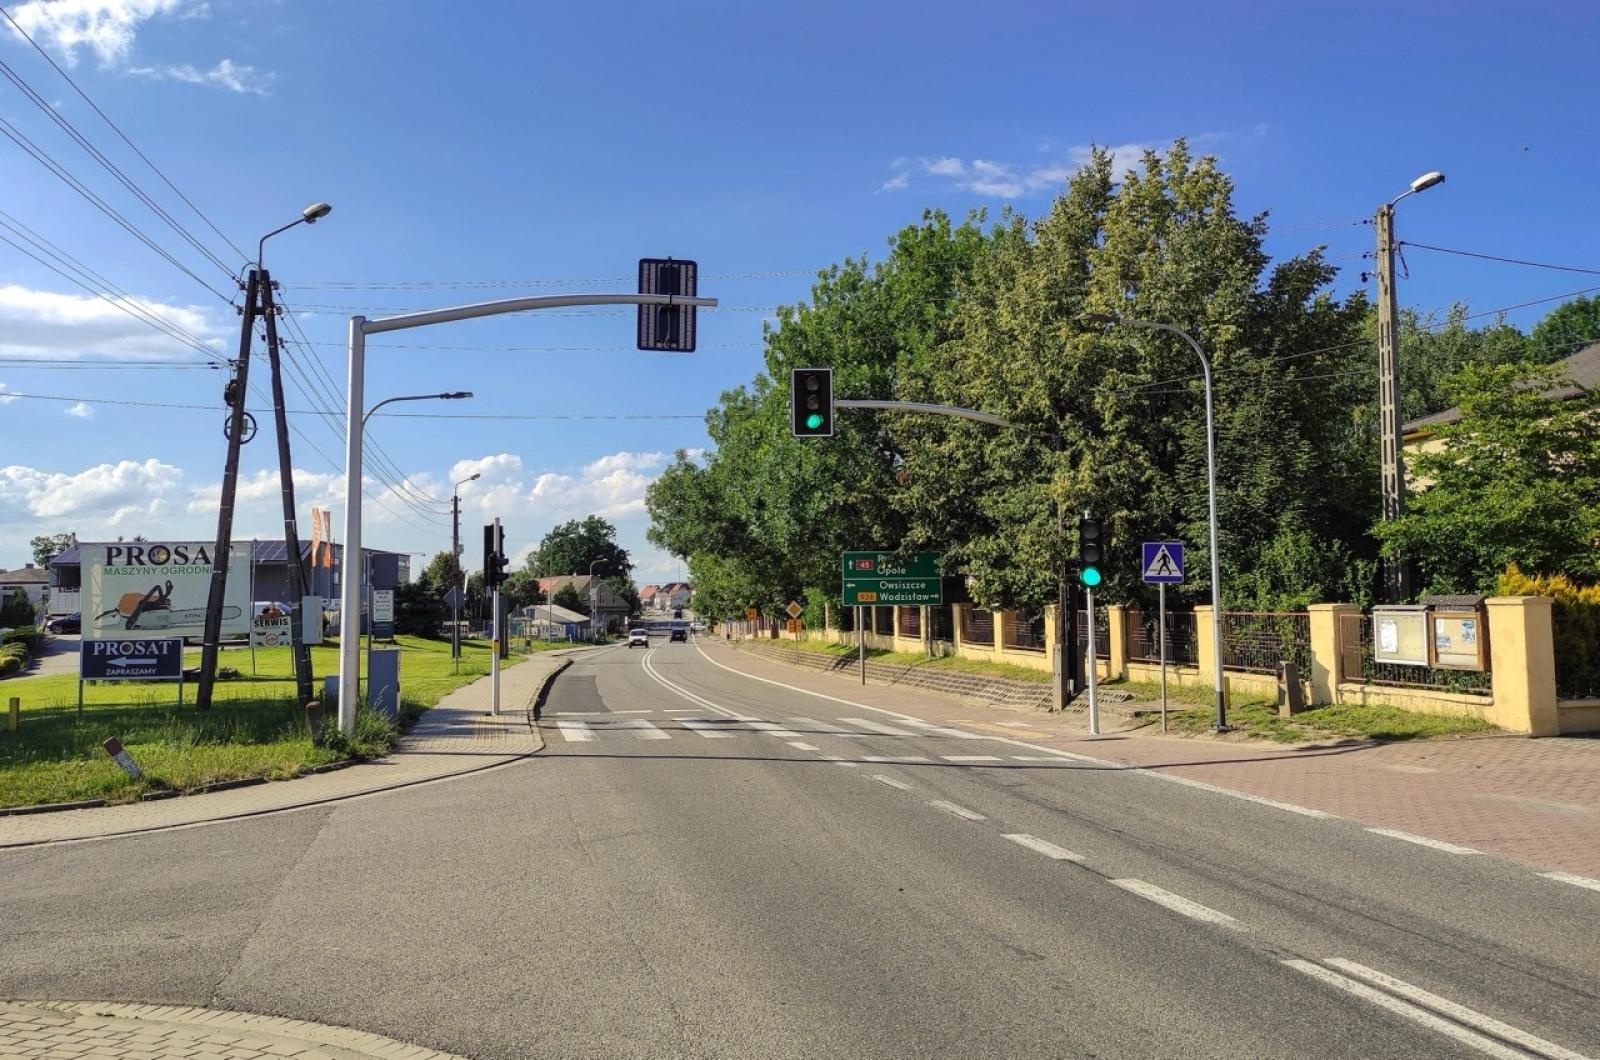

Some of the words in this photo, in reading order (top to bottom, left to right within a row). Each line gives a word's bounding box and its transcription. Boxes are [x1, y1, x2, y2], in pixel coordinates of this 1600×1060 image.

[104, 545, 233, 566] PROSA
[104, 566, 157, 576] MASZYNY
[160, 565, 233, 575] OGRODNIE
[877, 565, 906, 576] Opole
[880, 581, 926, 590] Owsiszcze
[880, 592, 930, 601] Wodzisław
[254, 618, 289, 627] SERWIS
[93, 641, 171, 655] PROSAT
[105, 667, 156, 675] ZAPRASZAMY
